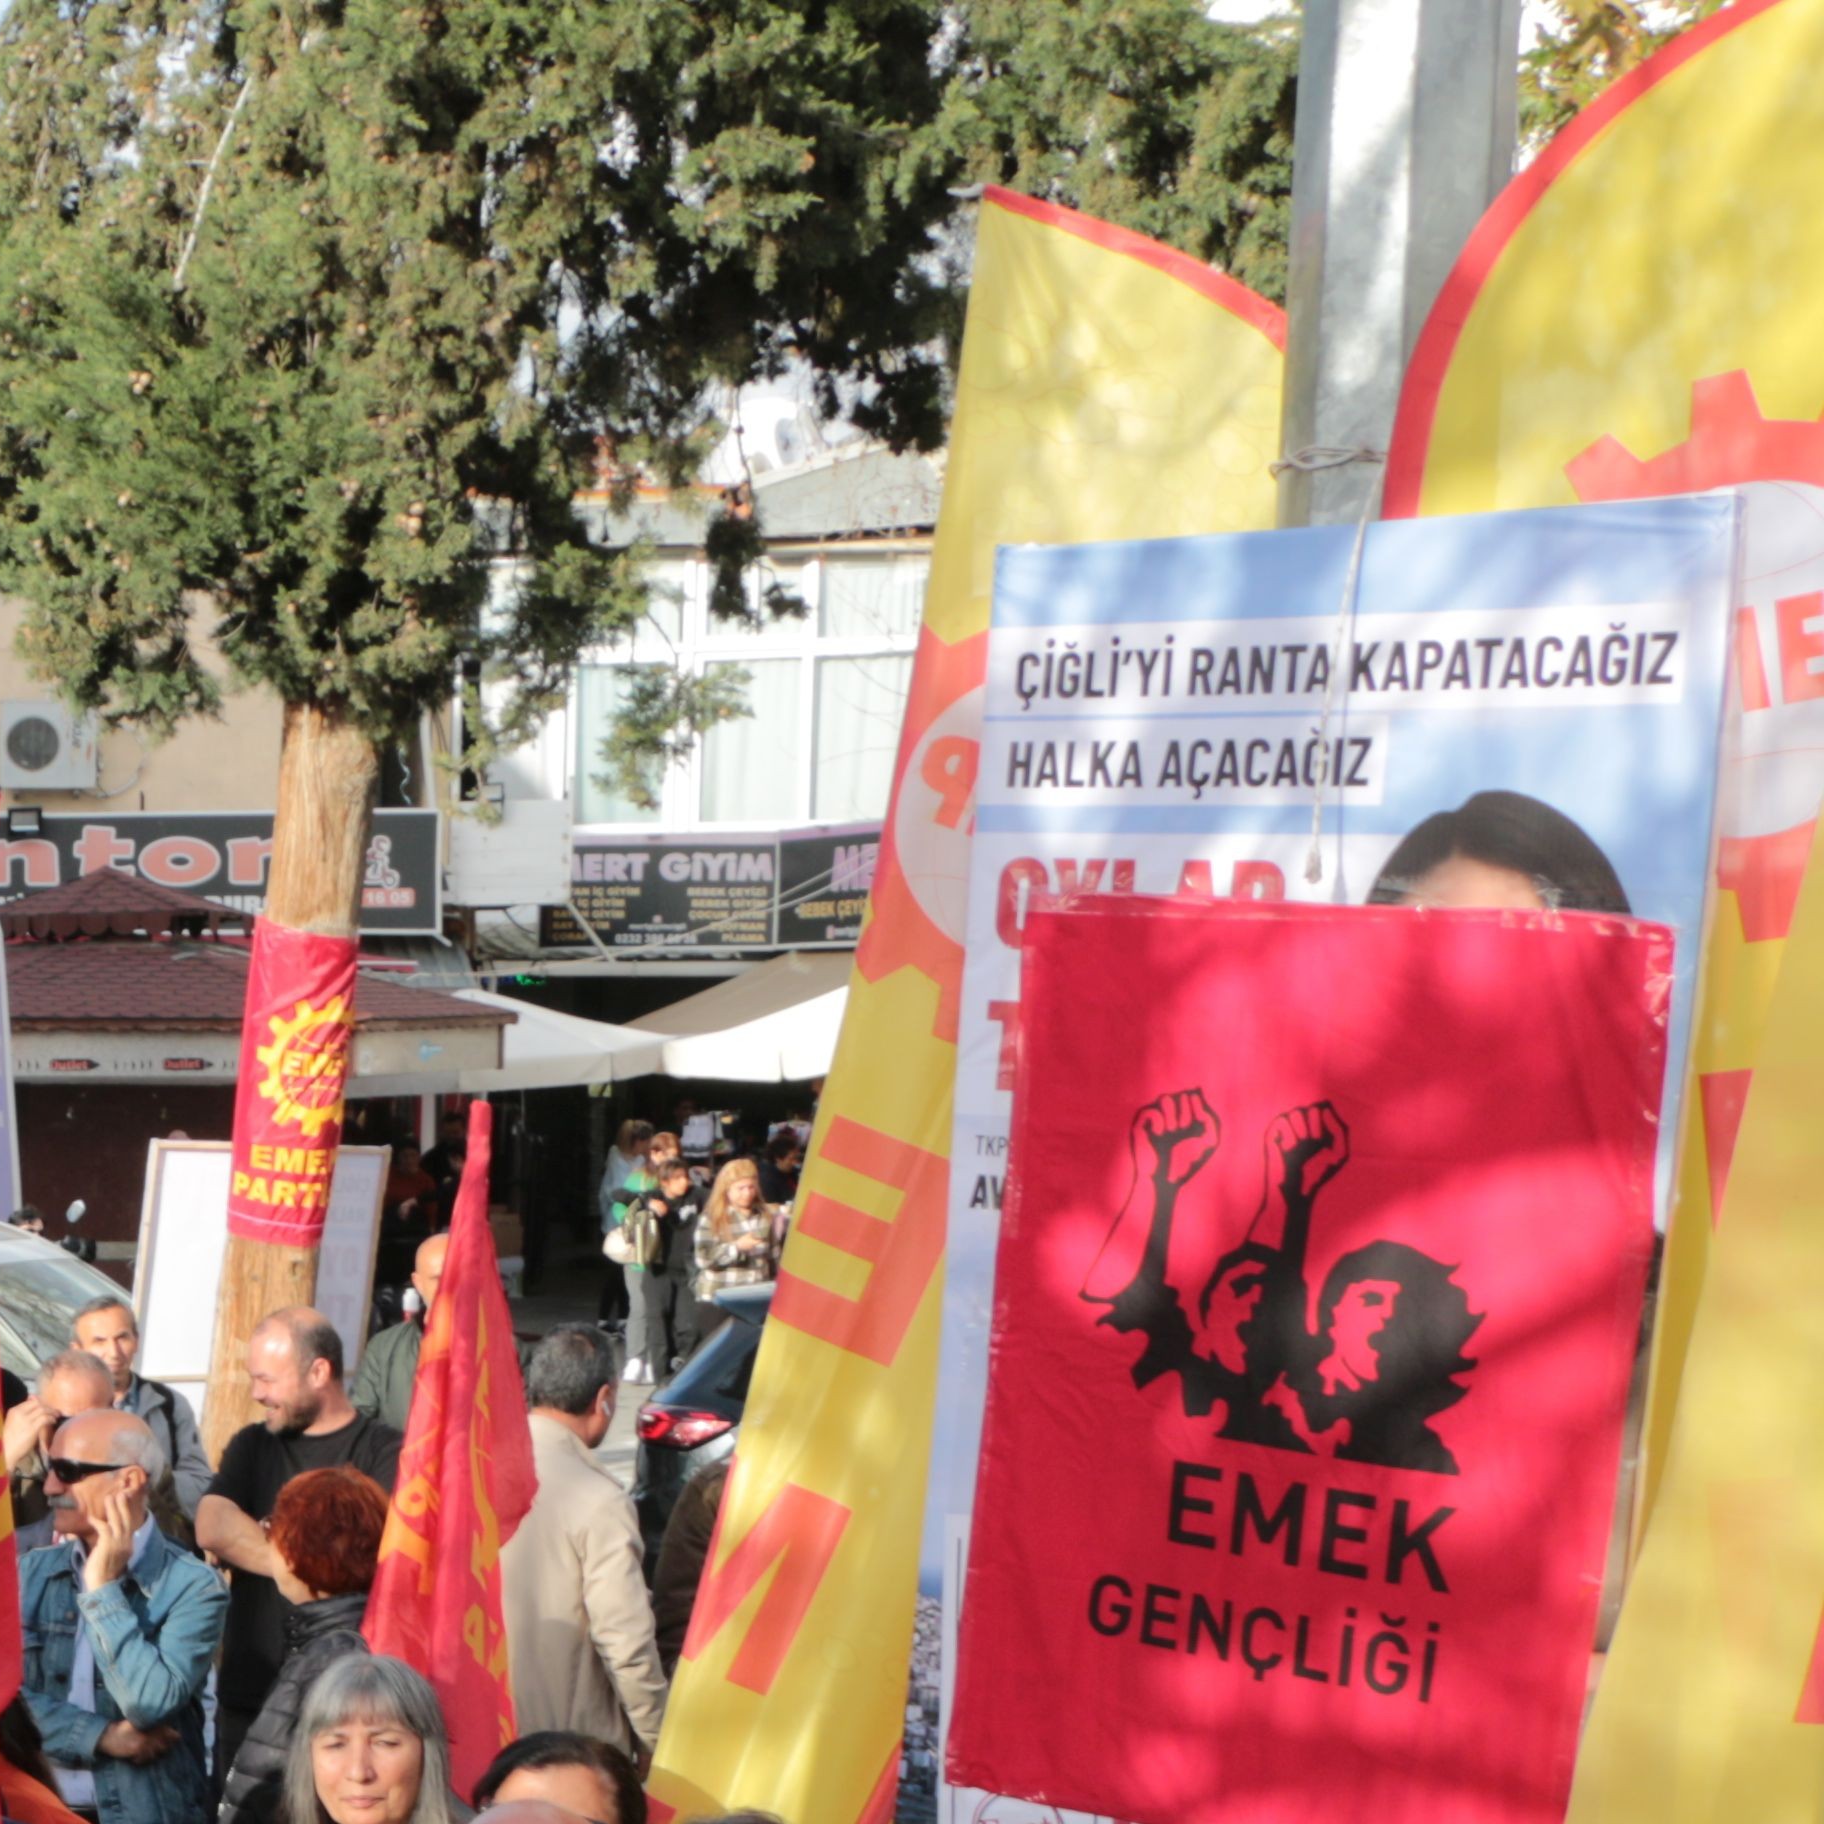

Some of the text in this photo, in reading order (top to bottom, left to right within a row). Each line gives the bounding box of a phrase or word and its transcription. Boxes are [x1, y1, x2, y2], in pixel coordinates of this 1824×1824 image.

[1188, 642, 1331, 696] RANTA
[1350, 621, 1680, 694] KAPATACAĞIZ
[1005, 740, 1144, 790] HALKA
[1157, 731, 1373, 799] AÇACAĞIZ
[1167, 1461, 1457, 1595] EMEK
[1086, 1572, 1443, 1704] GENÇLİĞİ
